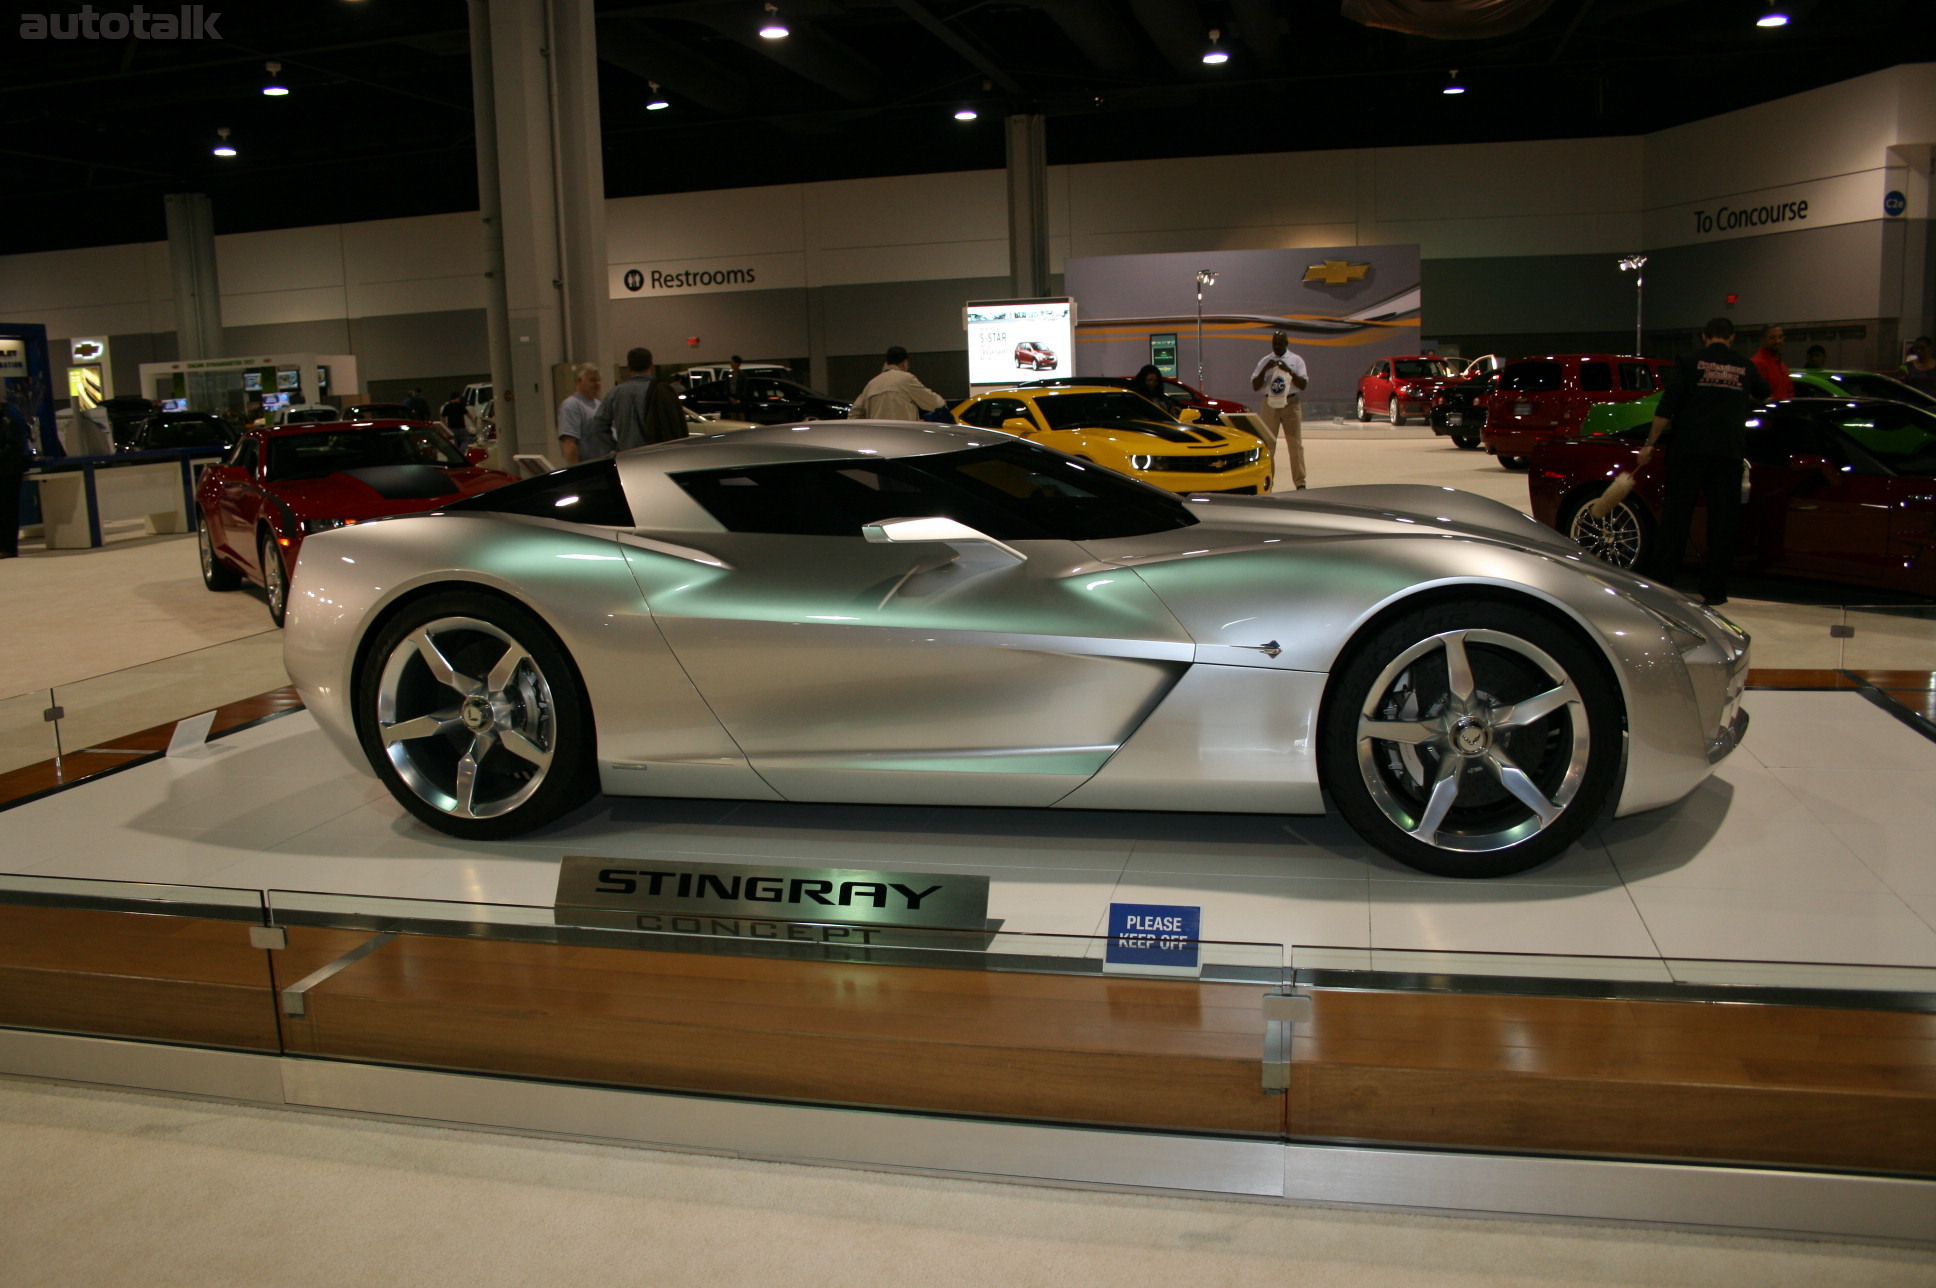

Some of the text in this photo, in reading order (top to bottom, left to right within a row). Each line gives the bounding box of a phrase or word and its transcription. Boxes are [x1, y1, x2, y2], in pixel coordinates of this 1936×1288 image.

[1694, 200, 1808, 233] To Concourse
[651, 268, 756, 289] Restrooms
[595, 869, 943, 909] STINGRAY
[636, 914, 882, 946] CONCEPT
[1126, 915, 1182, 931] PLEASE
[1118, 933, 1188, 950] KEEP OFF
